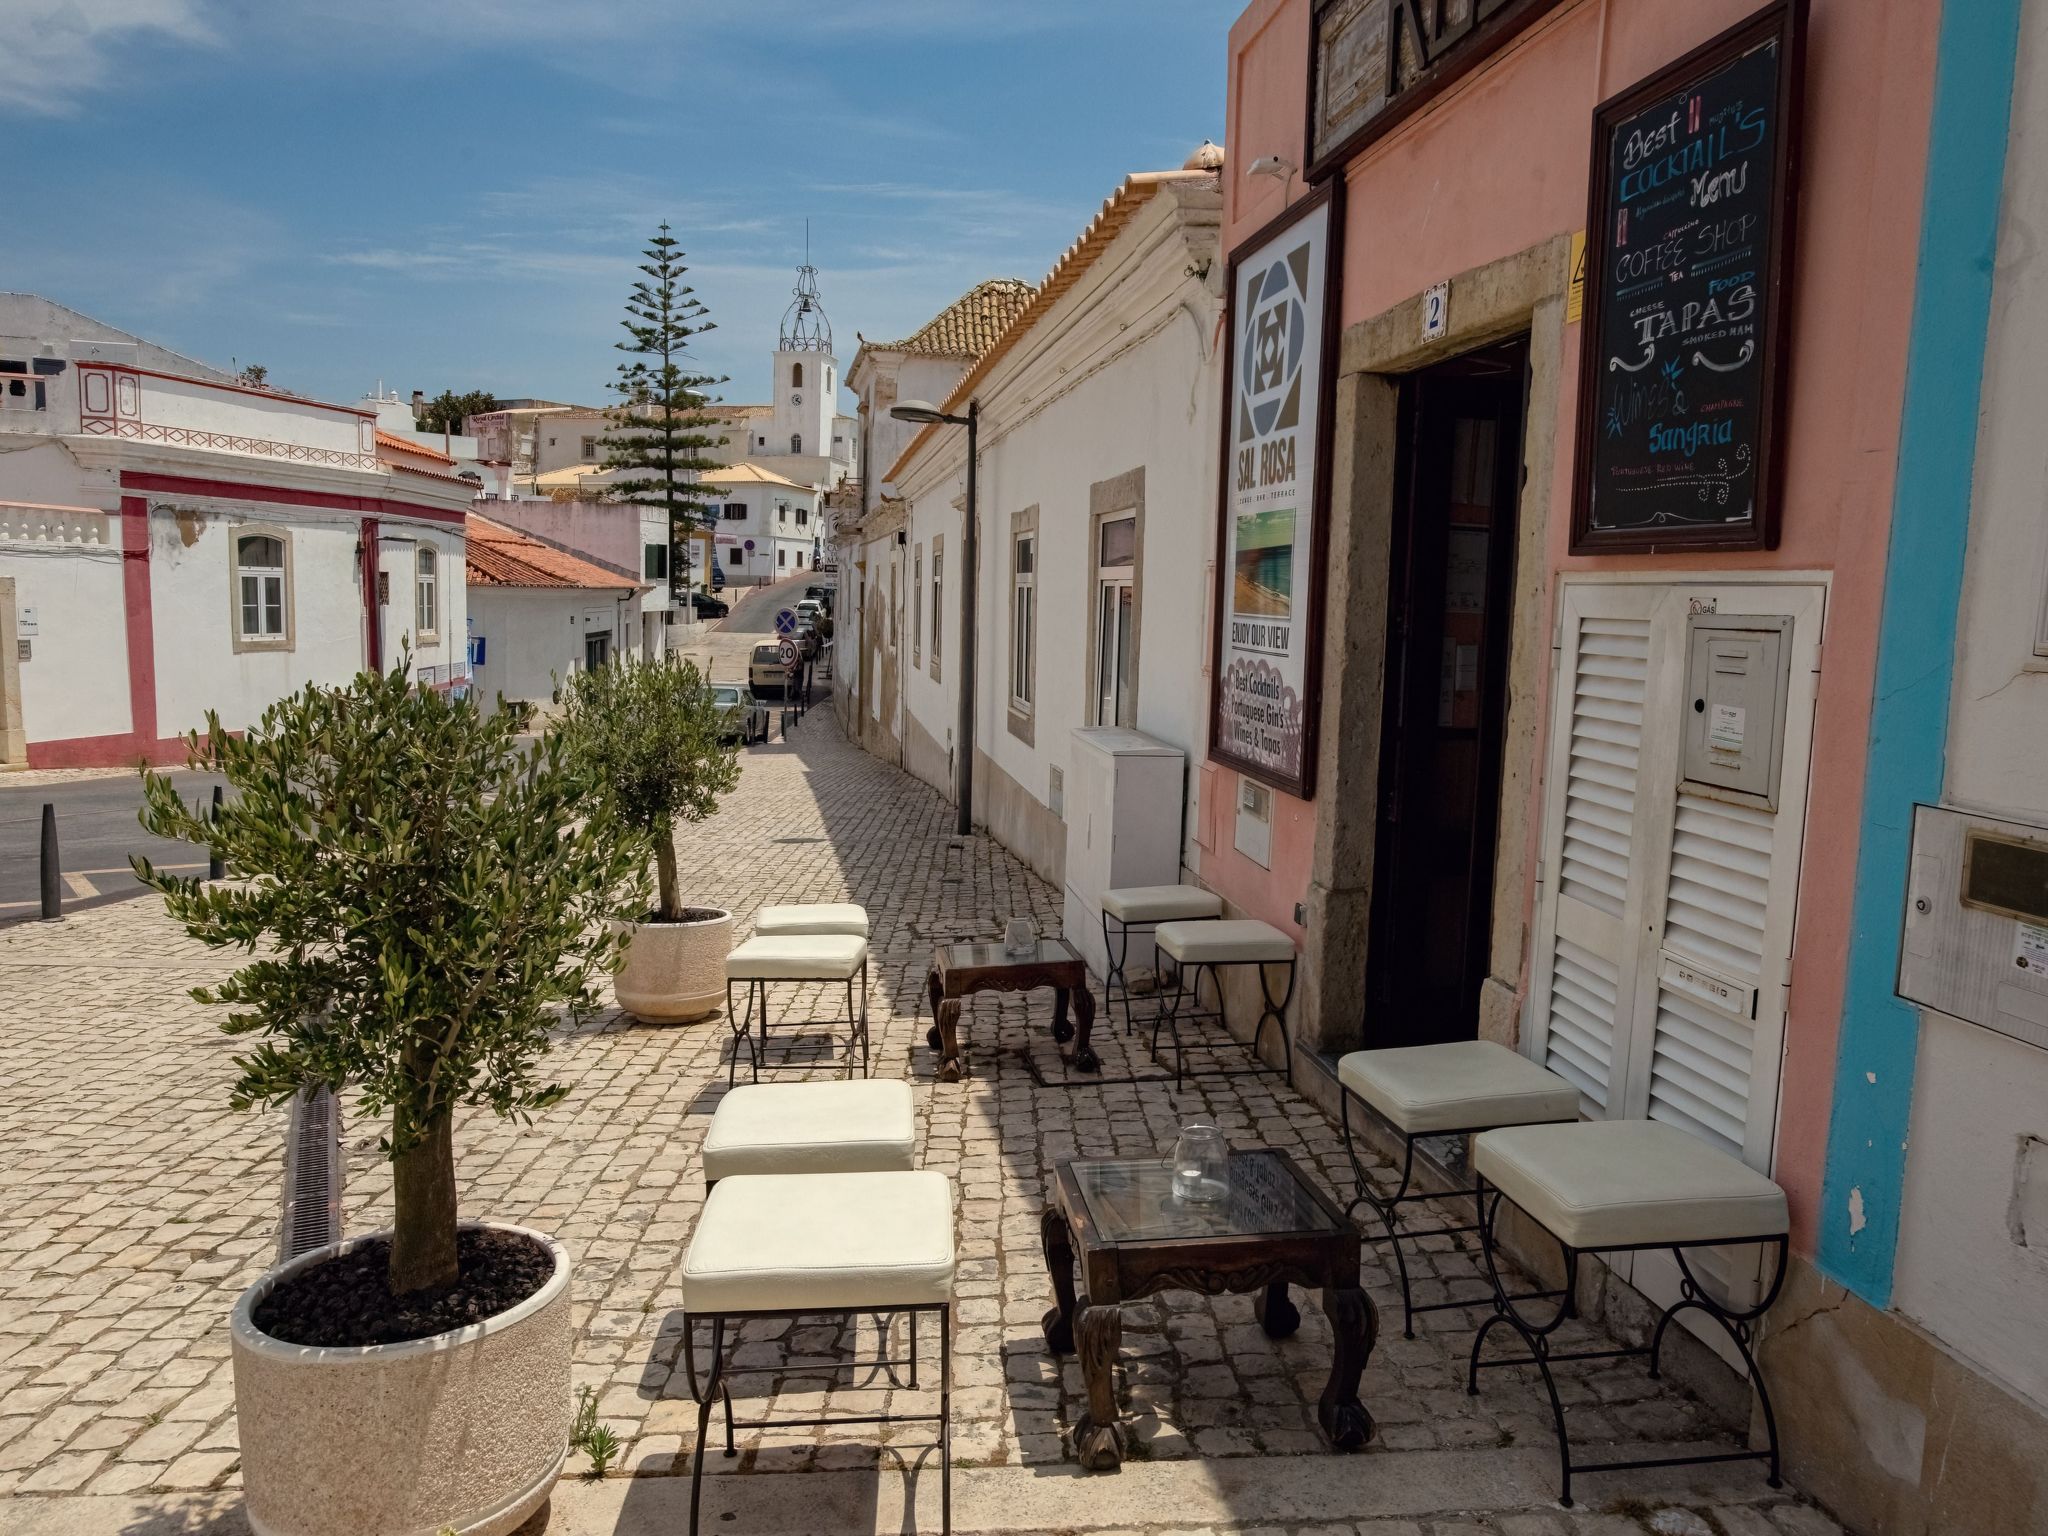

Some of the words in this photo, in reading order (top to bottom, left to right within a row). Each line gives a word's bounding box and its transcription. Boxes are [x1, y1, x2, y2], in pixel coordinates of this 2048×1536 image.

[1690, 161, 1748, 208] Menu
[1616, 238, 1687, 283] COFFEE
[1694, 214, 1757, 255] SHOP
[1669, 271, 1684, 285] TEA
[1708, 271, 1756, 297] FOOD
[1429, 296, 1440, 330] 2
[1629, 300, 1665, 318] CHEESE
[1634, 284, 1757, 347] TAPAS
[1682, 329, 1726, 348] SMOKED
[1729, 322, 1754, 338] HAM
[1238, 446, 1255, 492] SAL
[1260, 436, 1296, 486] ROSA
[1270, 489, 1296, 501] TERRACE
[1232, 622, 1250, 645] ENJOY
[1251, 624, 1266, 648] OUR
[1267, 626, 1290, 651] VIEW
[780, 647, 794, 659] 20
[1235, 669, 1248, 693] Best
[1249, 672, 1280, 700] Cocktails
[1231, 694, 1265, 725] Portuguese
[1266, 703, 1284, 729] Gin's
[1233, 719, 1253, 746] Wines
[1254, 726, 1259, 748] &
[1260, 728, 1281, 758] Tapas
